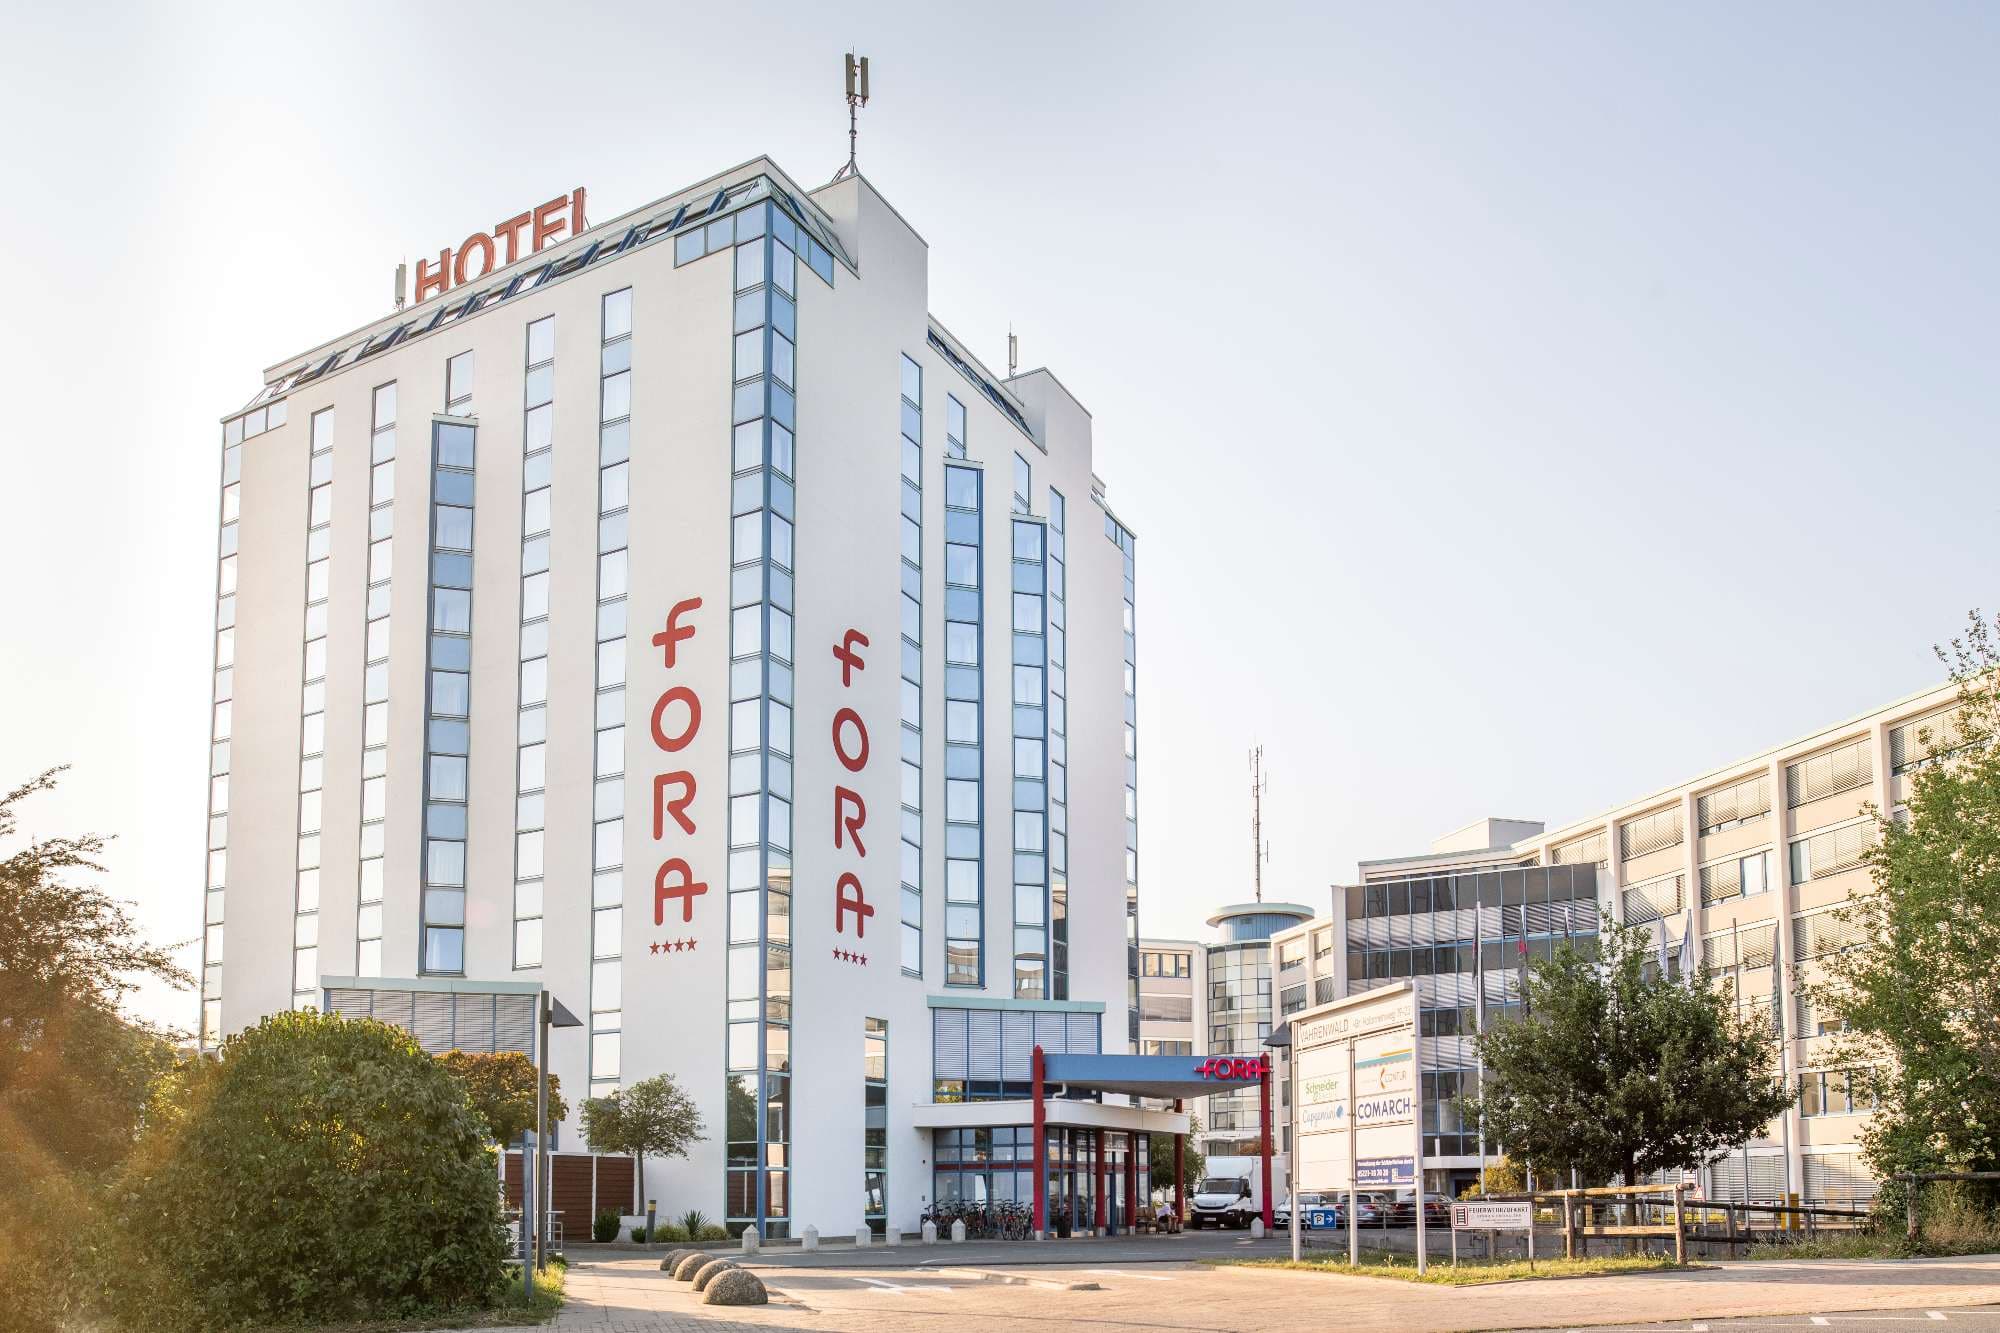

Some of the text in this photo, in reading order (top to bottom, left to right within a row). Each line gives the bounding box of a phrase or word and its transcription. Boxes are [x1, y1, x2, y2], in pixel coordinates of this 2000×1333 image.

[1194, 1058, 1272, 1080] FORA
[1305, 1080, 1339, 1095] Schneider
[1358, 1097, 1411, 1120] COMARCH
